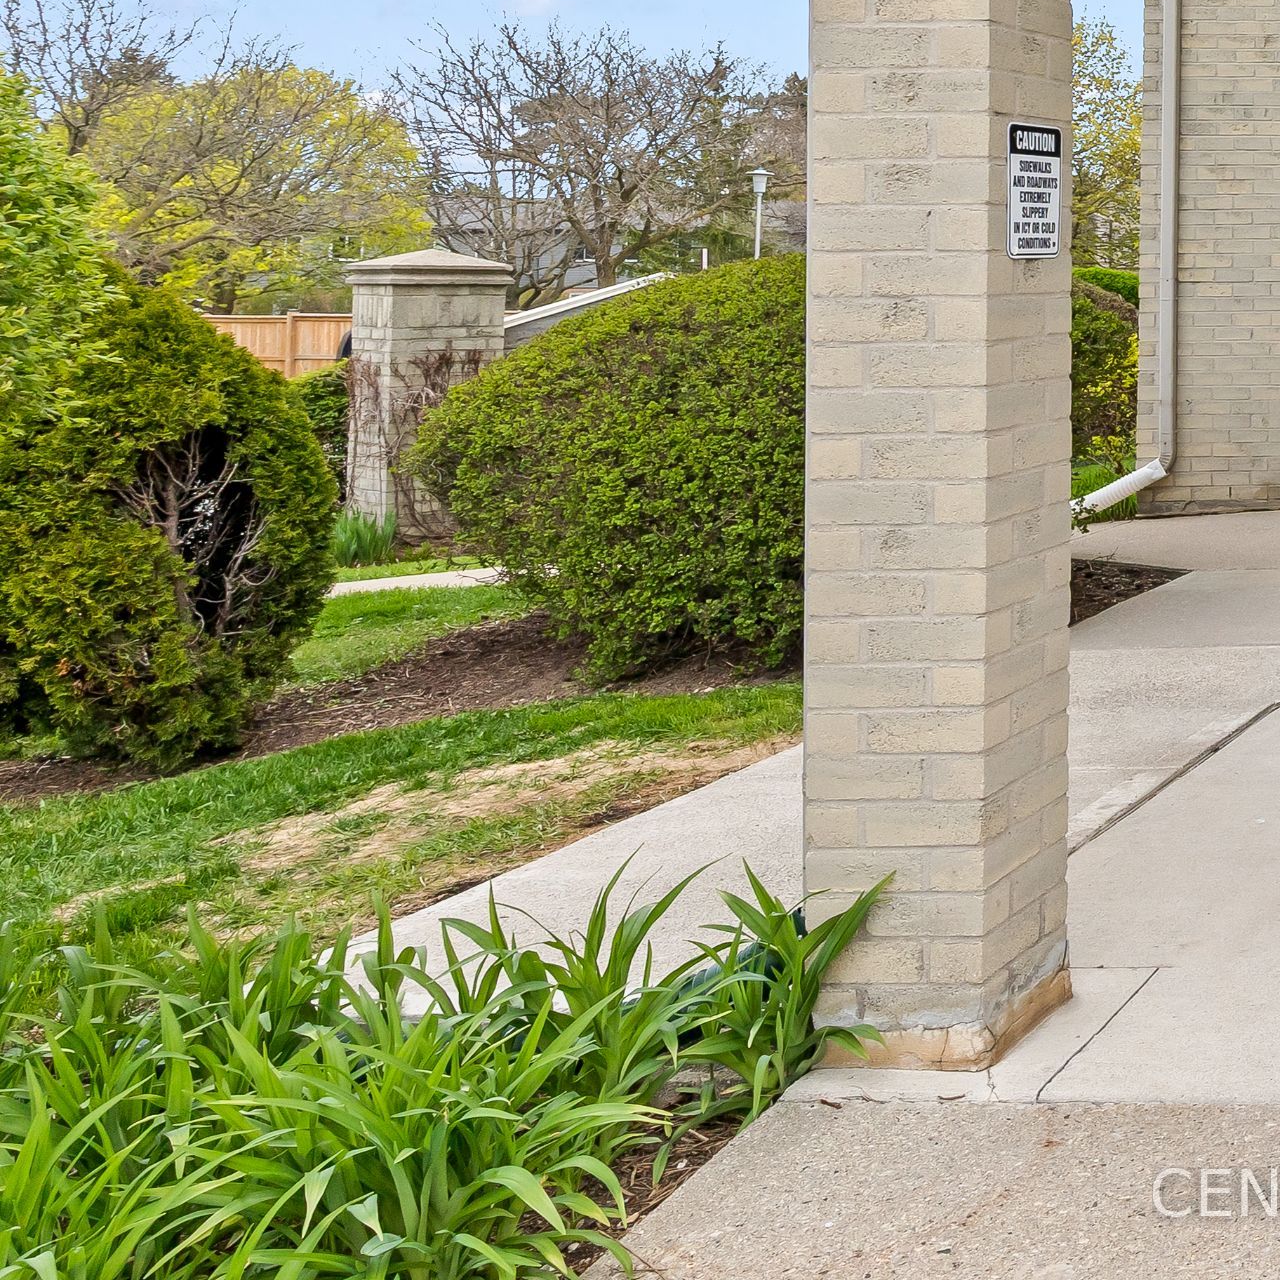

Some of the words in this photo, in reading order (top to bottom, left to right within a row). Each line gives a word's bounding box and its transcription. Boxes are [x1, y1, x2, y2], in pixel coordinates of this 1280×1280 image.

[1016, 130, 1055, 153] CAUTION
[1019, 159, 1052, 174] SIDEWALKS
[1013, 175, 1025, 188] AND
[1026, 176, 1058, 190] ROADWAYS
[1019, 191, 1051, 204] EXTREMELY
[1022, 206, 1049, 219] SLIPPERY
[1013, 221, 1020, 234] IN
[1021, 221, 1031, 234] ICY
[1032, 221, 1040, 234] OR
[1041, 222, 1056, 234] COLD
